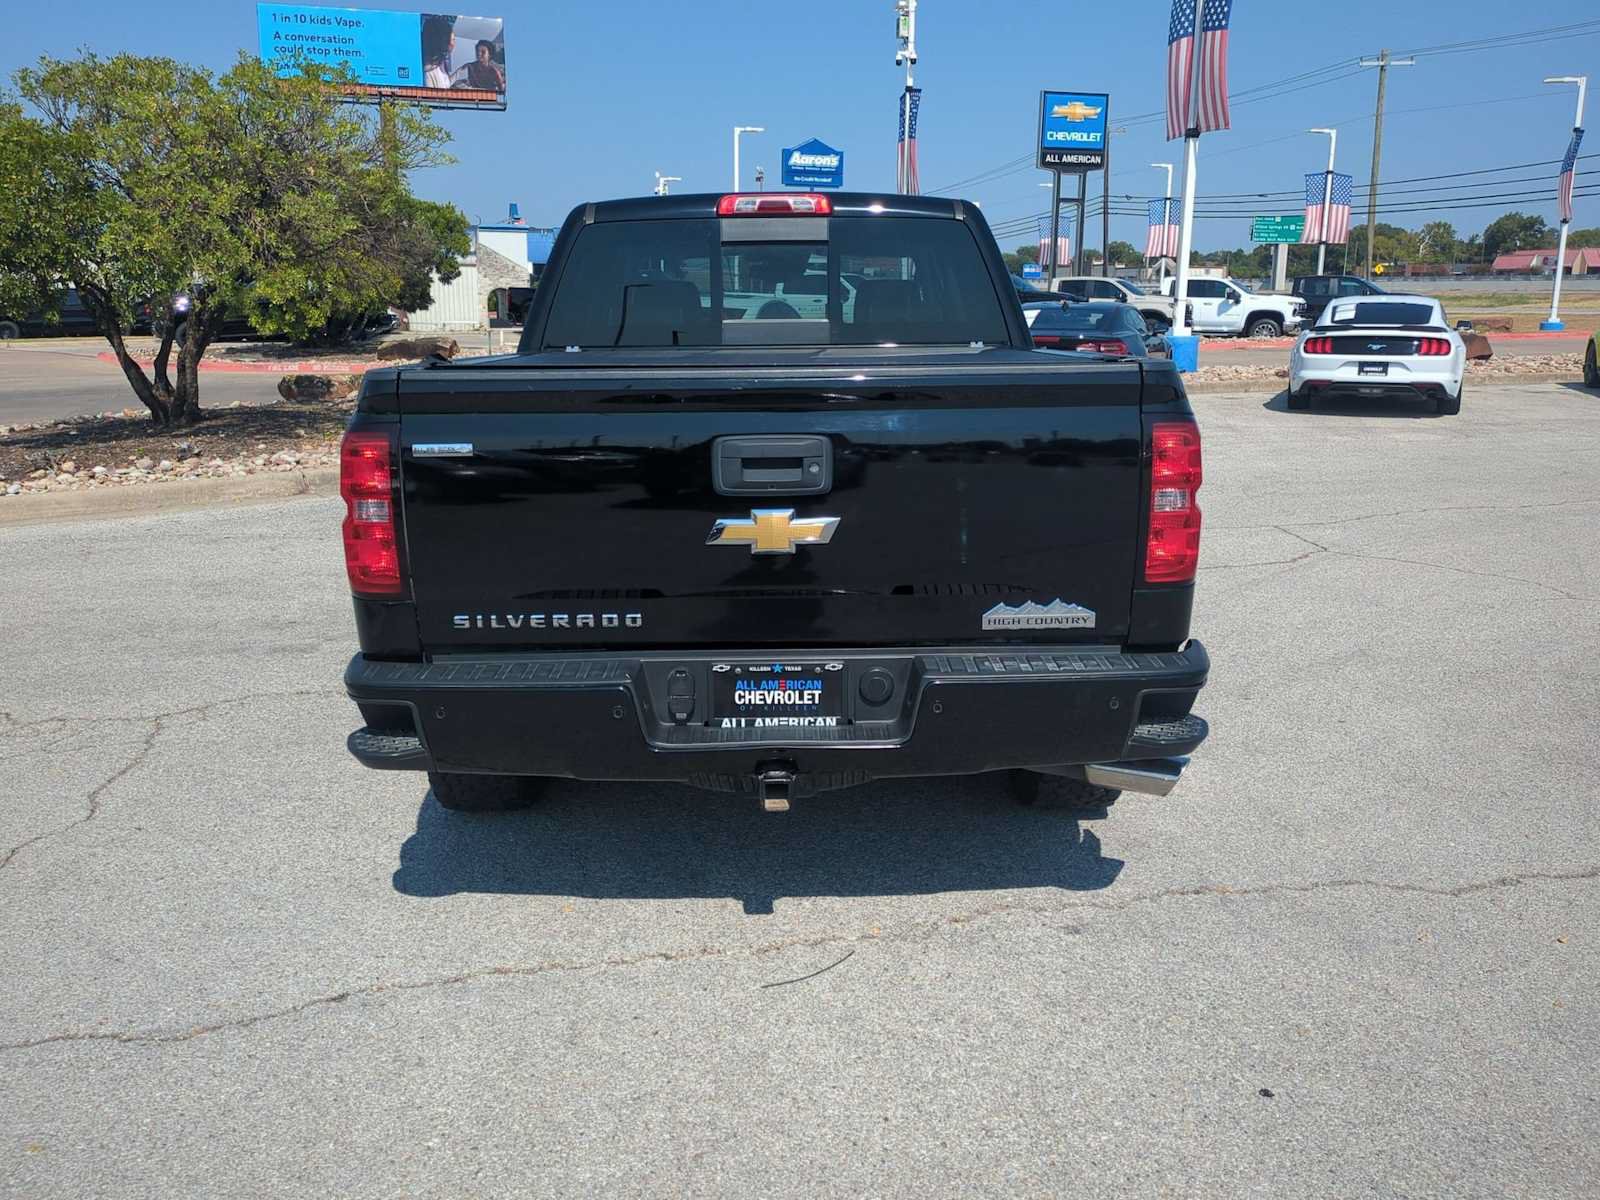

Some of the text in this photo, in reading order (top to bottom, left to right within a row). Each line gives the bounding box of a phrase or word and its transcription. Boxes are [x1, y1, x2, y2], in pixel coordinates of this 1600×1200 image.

[272, 13, 365, 28] 1 in 10 kids Vape.
[273, 31, 354, 45] A conversation
[274, 44, 365, 57] could stop them.
[1047, 131, 1102, 142] CHEVROLET
[788, 150, 840, 167] Aaron's
[1045, 154, 1101, 164] ALL AMERICAN
[453, 613, 642, 628] SILVERADO
[988, 615, 1089, 625] HIGH COUNTRY
[736, 679, 822, 690] ALL AMERICAN
[734, 690, 822, 705] CHEVROLET
